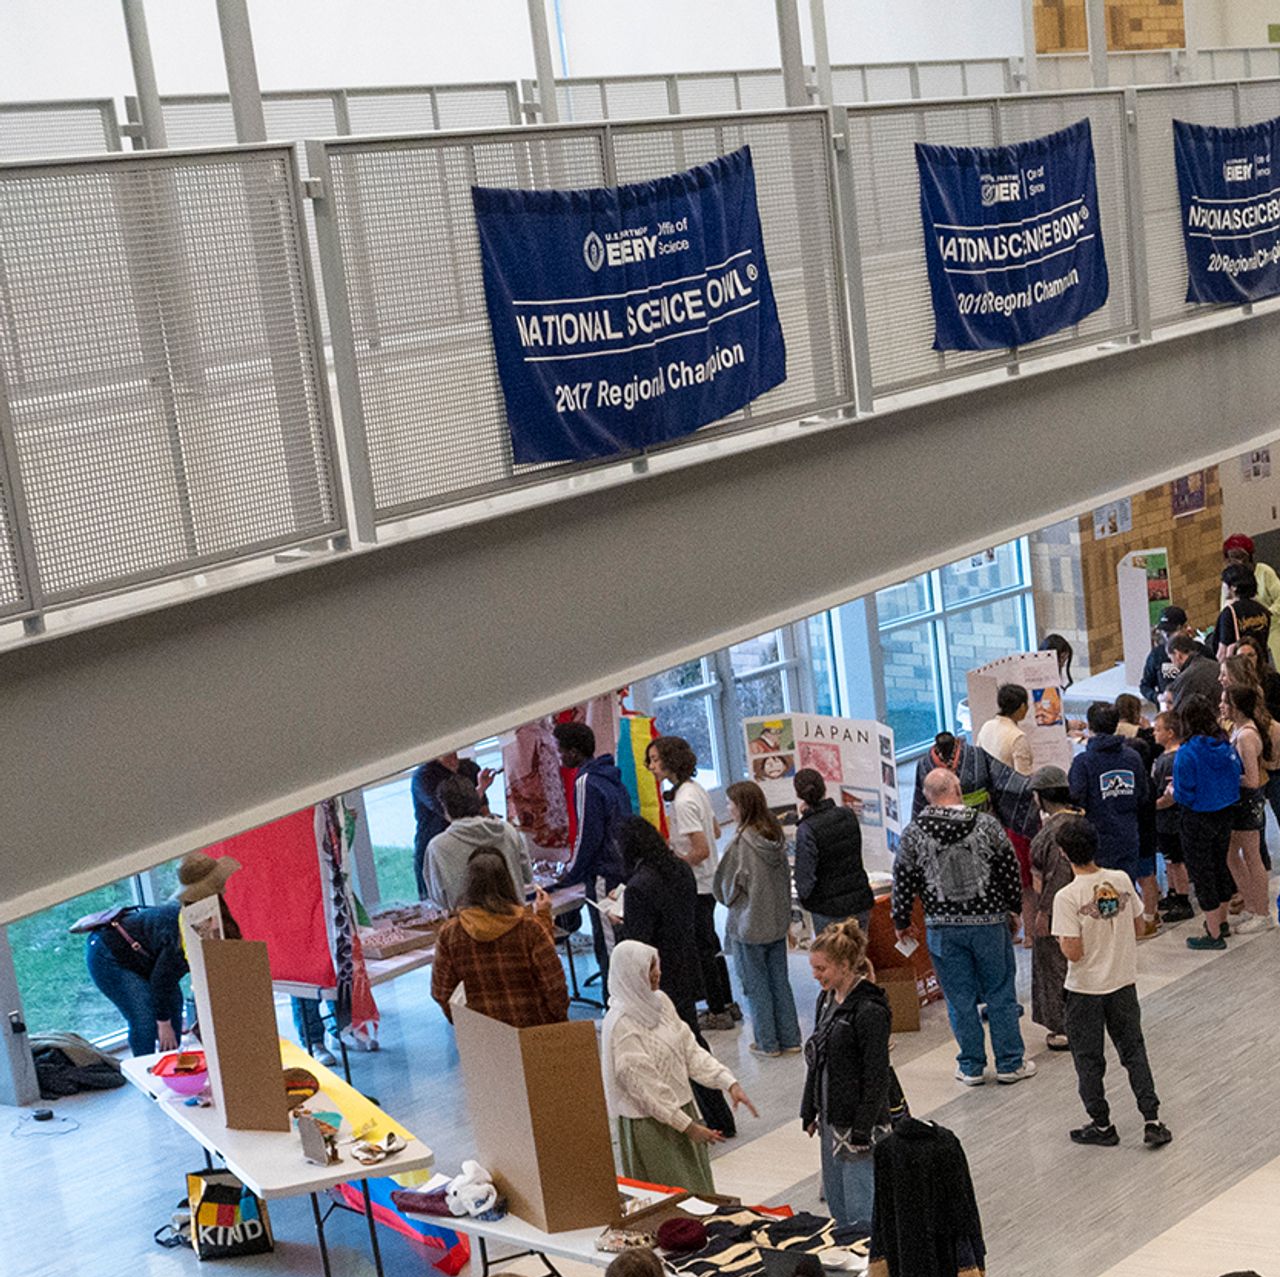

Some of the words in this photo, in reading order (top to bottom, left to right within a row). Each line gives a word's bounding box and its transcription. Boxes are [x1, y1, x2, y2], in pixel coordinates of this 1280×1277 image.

[554, 382, 593, 413] 2017
[804, 720, 870, 744] JAPAN
[198, 1218, 264, 1246] KIND
